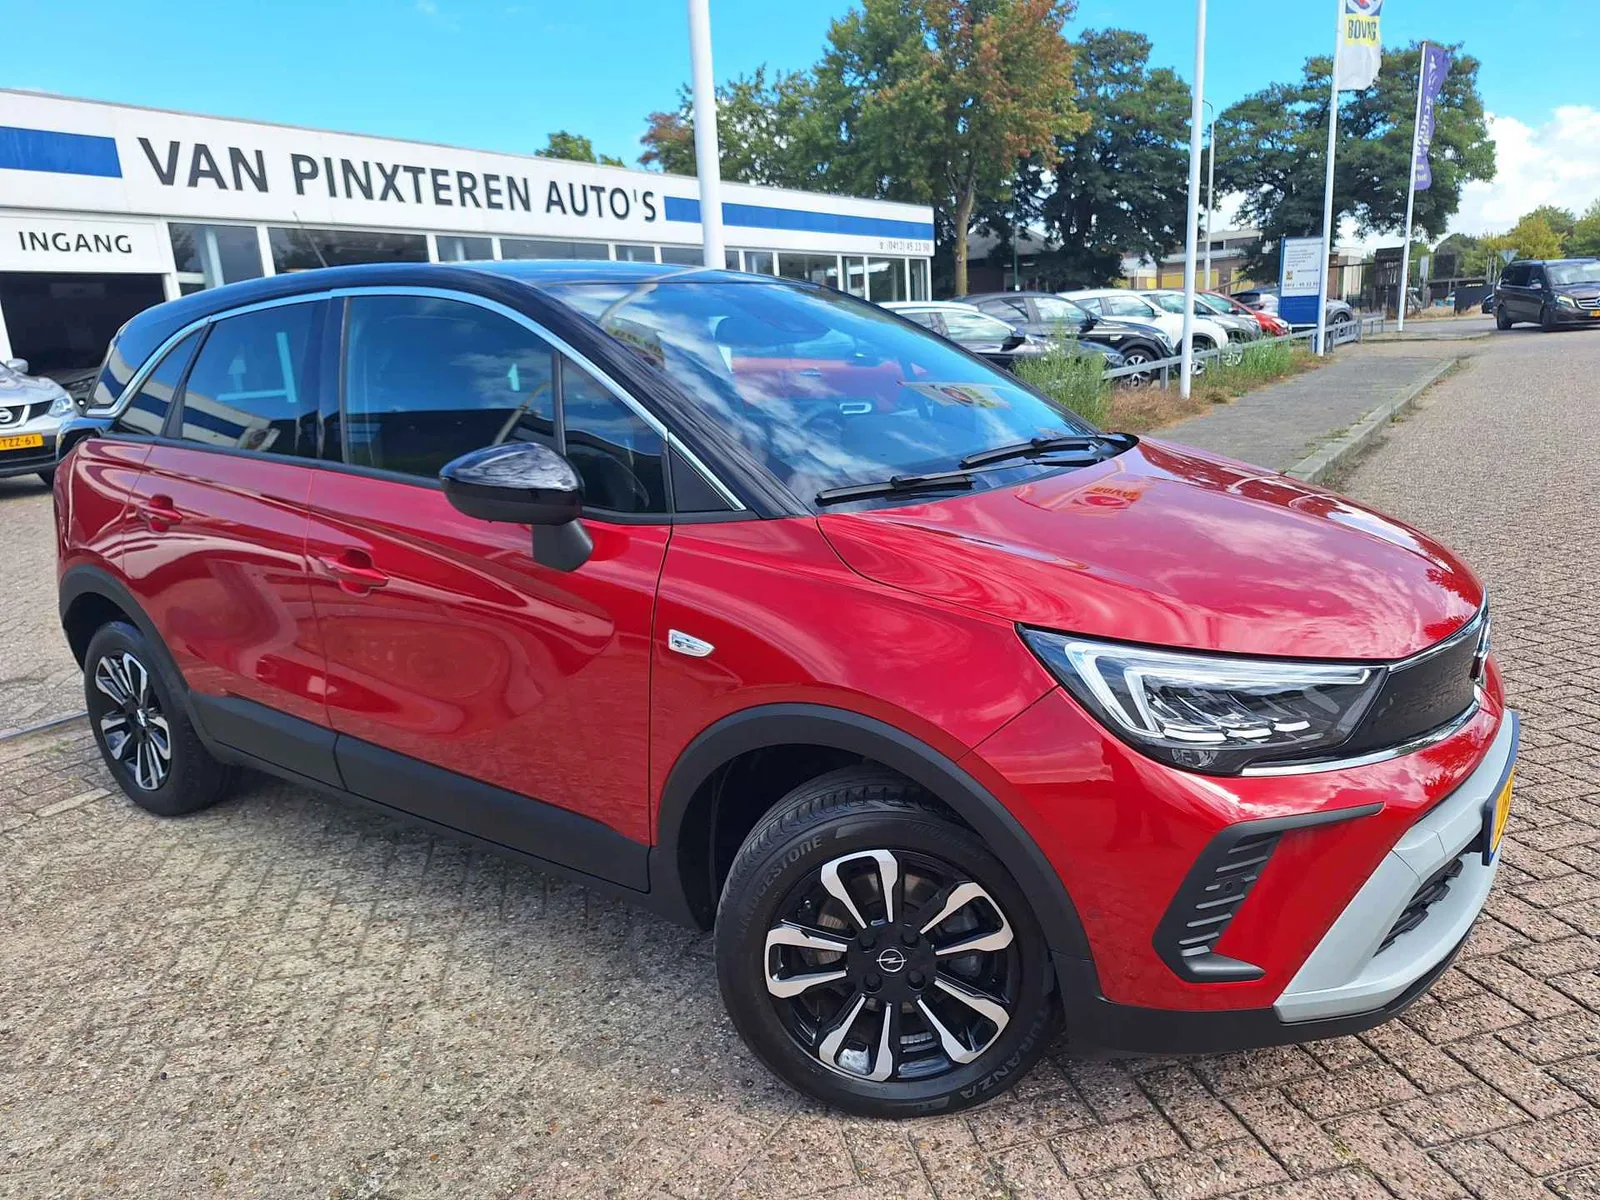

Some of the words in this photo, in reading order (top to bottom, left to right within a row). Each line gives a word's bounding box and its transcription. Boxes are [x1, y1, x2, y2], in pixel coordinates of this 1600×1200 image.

[136, 137, 269, 193] VAN
[290, 153, 532, 212] PINXTEREN
[546, 180, 656, 223] AUTO'S
[18, 231, 132, 253] INGANG
